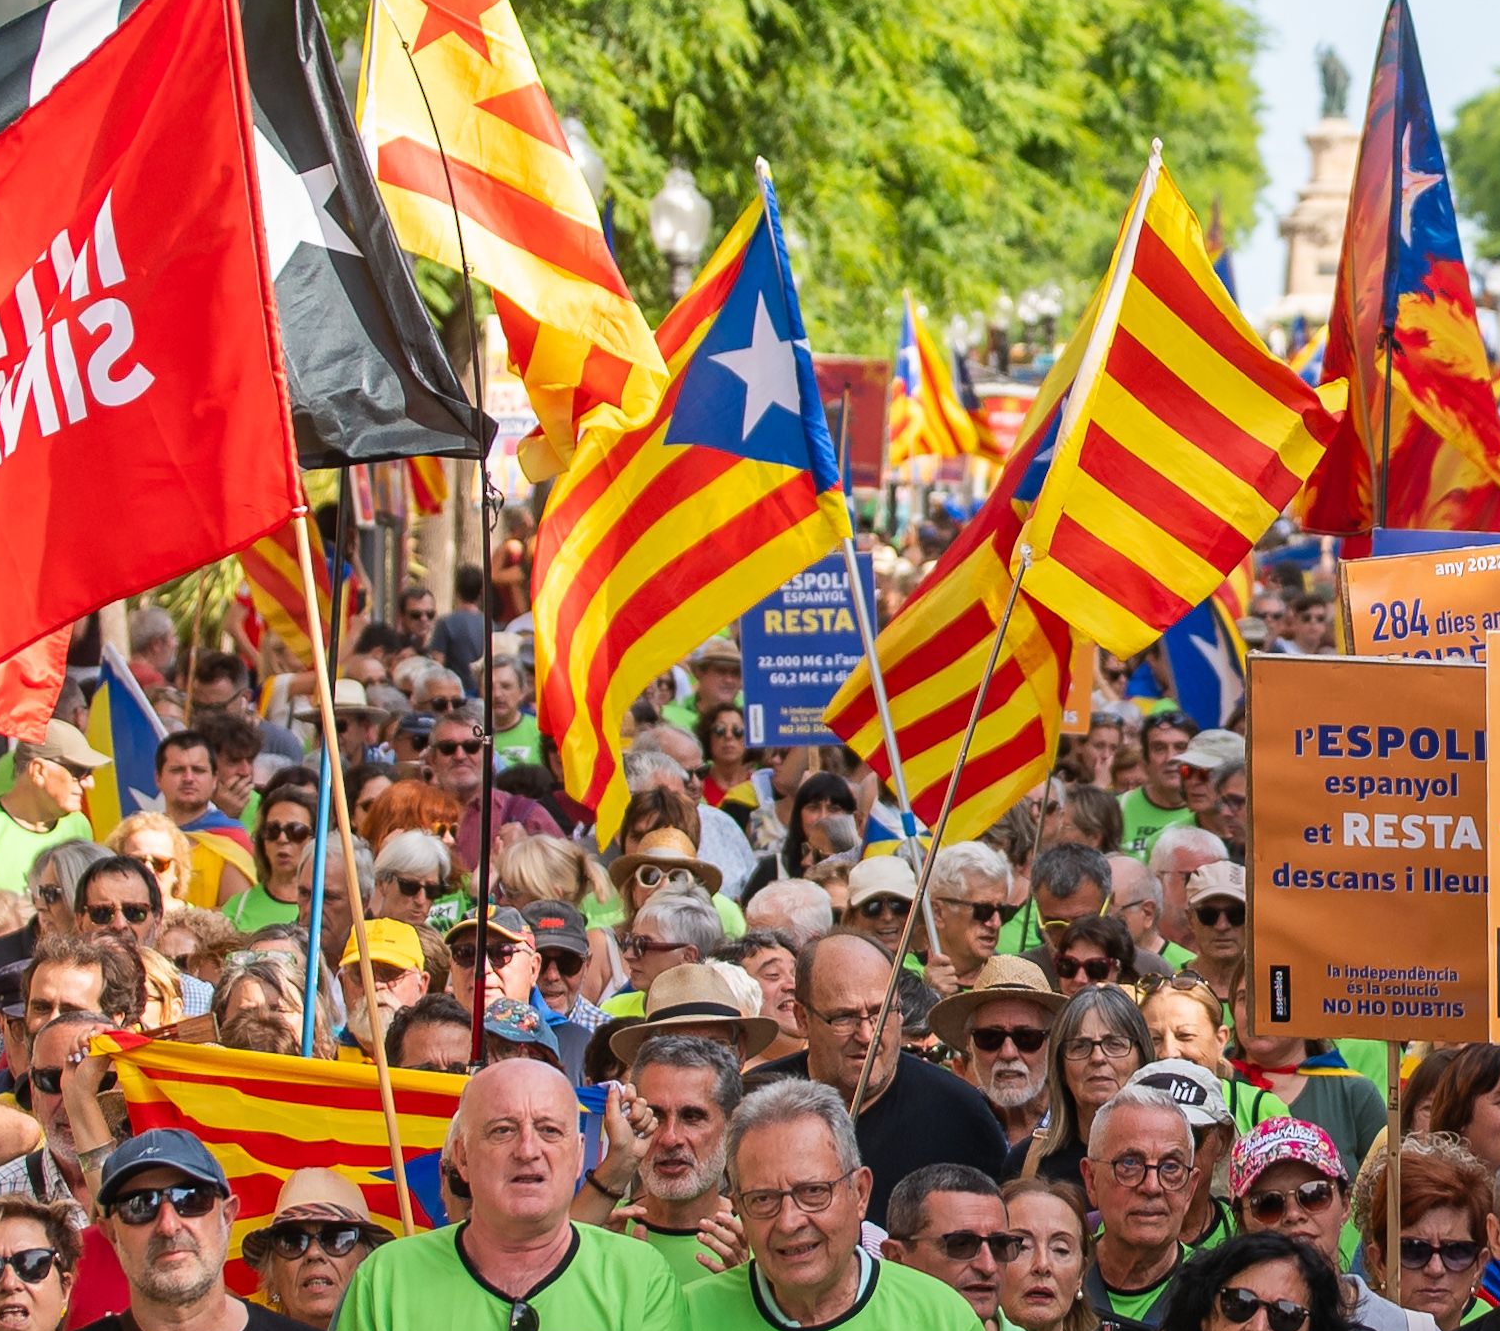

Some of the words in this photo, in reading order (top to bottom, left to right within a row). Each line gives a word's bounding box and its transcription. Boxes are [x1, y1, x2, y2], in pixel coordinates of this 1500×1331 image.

[1435, 560, 1464, 577] any
[783, 592, 848, 603] ESPANYOL
[764, 608, 855, 634] RESTA
[1371, 599, 1429, 641] 284
[1436, 609, 1476, 635] dies
[758, 656, 801, 668] 22.000
[803, 655, 822, 666] M€
[1295, 725, 1487, 762] l'ESPOLI
[1325, 773, 1459, 802] espanyol
[1304, 823, 1332, 843] et
[1342, 812, 1483, 851] RESTA
[1272, 863, 1396, 891] descans
[1405, 866, 1414, 892] i
[1327, 964, 1341, 978] la
[1344, 964, 1458, 982] independència
[1347, 981, 1363, 995] és
[1367, 981, 1381, 995] la
[1384, 981, 1439, 997] solució
[1322, 998, 1353, 1015] NO
[1356, 1000, 1387, 1016] HO
[1391, 1000, 1465, 1018] DUBTIS
